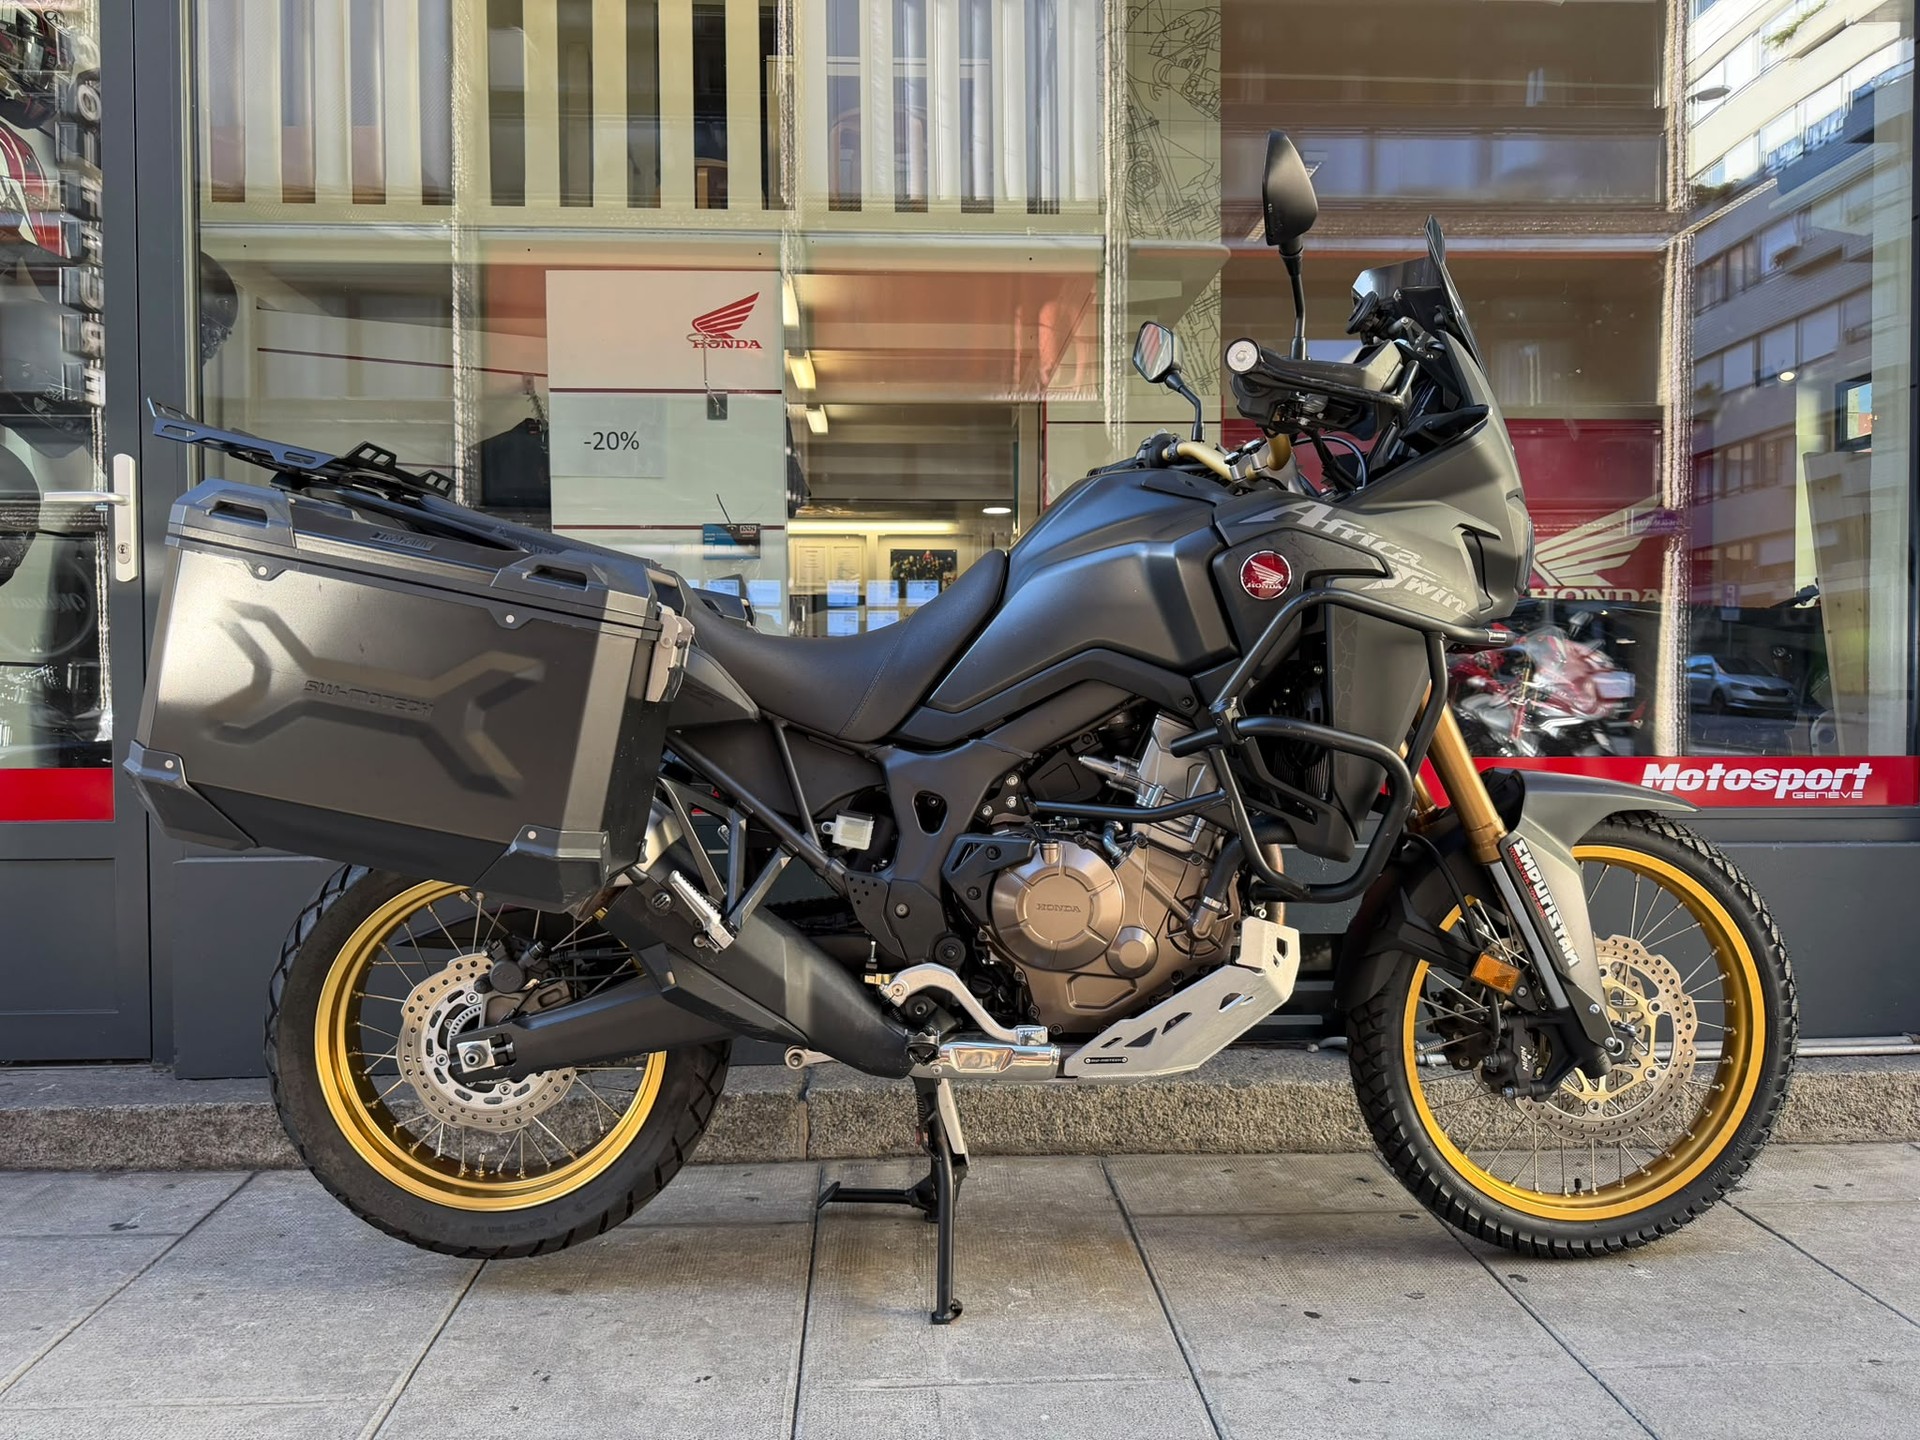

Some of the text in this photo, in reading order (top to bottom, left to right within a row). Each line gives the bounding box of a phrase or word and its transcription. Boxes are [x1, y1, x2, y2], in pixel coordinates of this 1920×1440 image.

[692, 340, 762, 349] HONDA
[583, 431, 640, 451] -20%
[1240, 500, 1441, 578] Africa
[1246, 582, 1283, 590] HONDA
[1362, 565, 1476, 621] Twin
[1530, 588, 1666, 602] HONDA
[1641, 762, 1873, 799] Motosport
[1036, 903, 1081, 912] HONDA
[1512, 838, 1580, 967] ENDURISTAN
